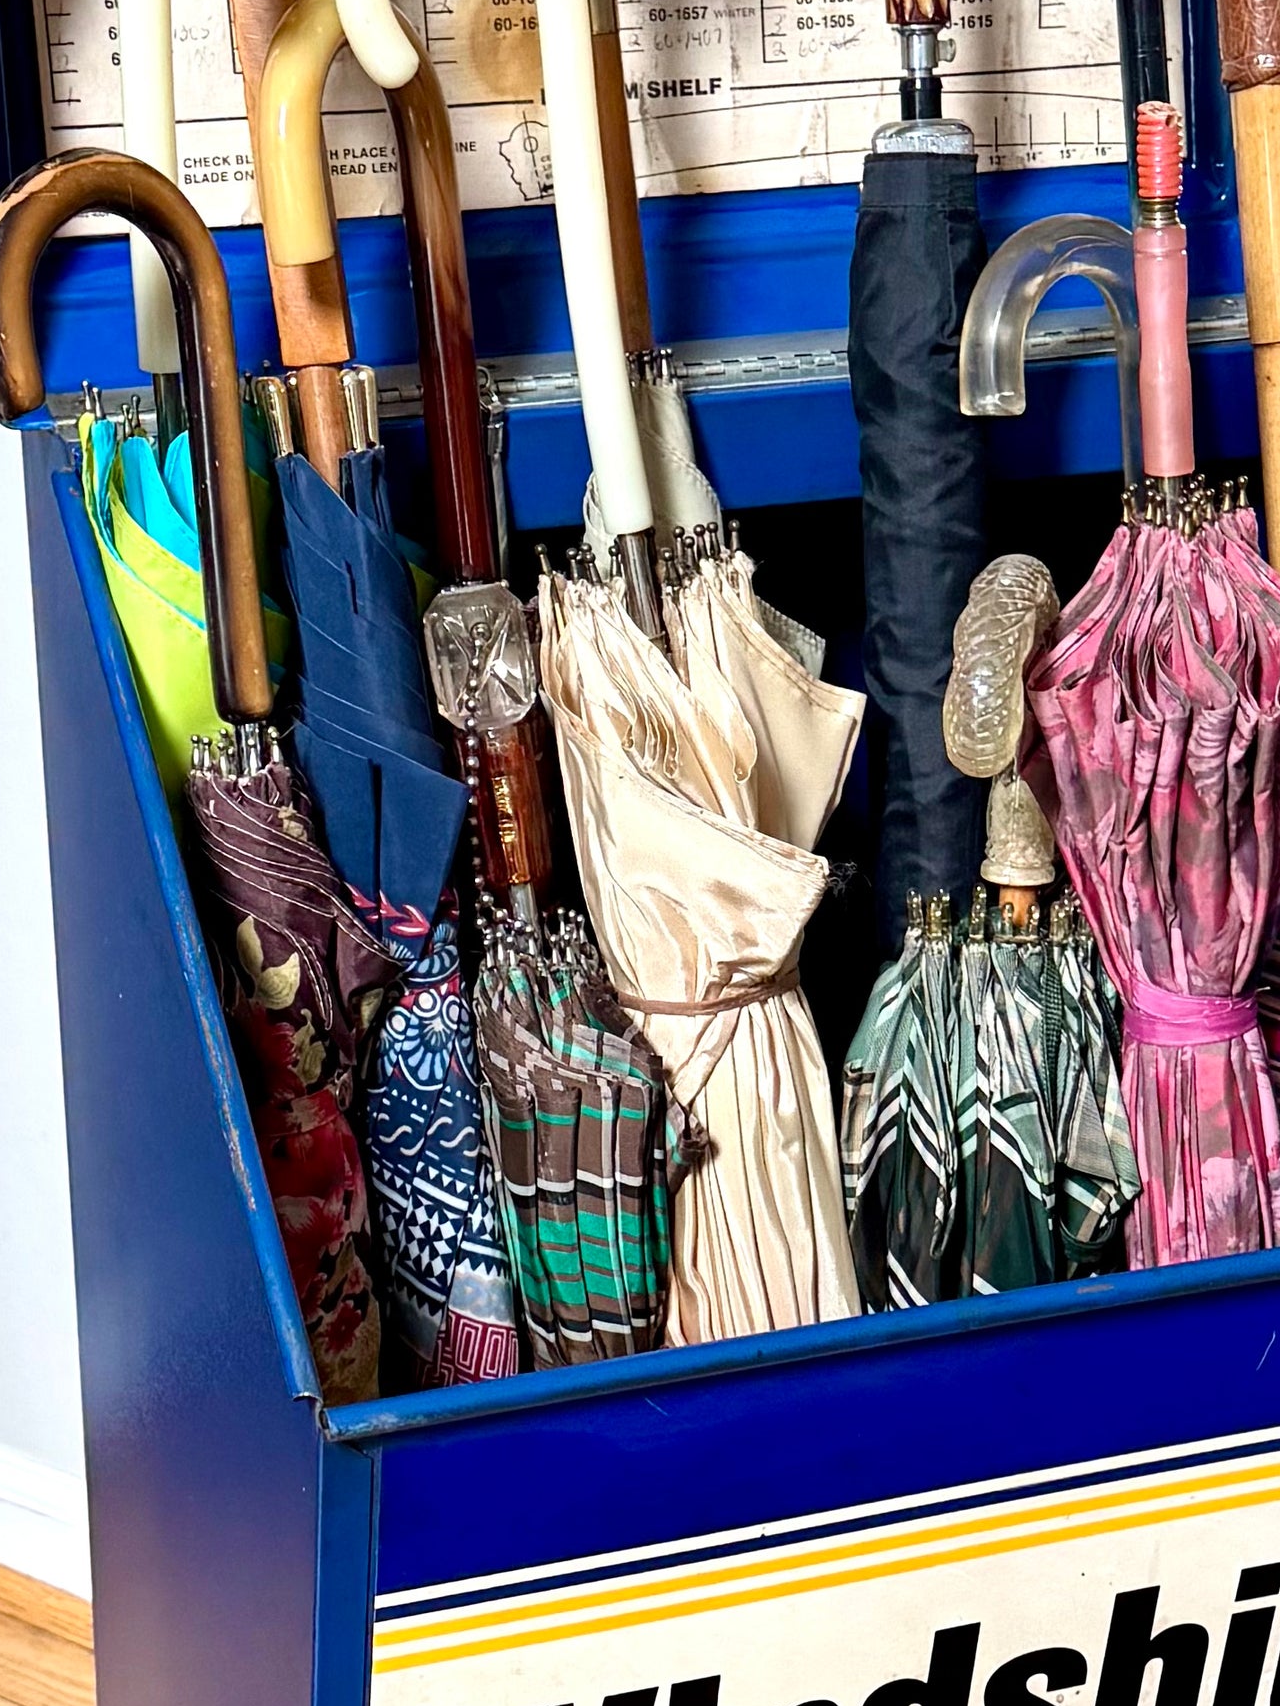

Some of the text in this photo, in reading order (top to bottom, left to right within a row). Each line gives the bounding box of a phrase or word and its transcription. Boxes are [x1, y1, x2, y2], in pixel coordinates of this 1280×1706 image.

[648, 7, 756, 22] 60-1657 WINTER
[953, 15, 993, 29] -1615
[494, 17, 537, 32] 60-16
[797, 15, 855, 30] 60-1505
[647, 77, 722, 98] SHELF
[184, 155, 231, 169] CHECK
[344, 147, 388, 159] PLACE
[456, 141, 477, 153] INE
[184, 171, 229, 184] BLADE
[331, 163, 366, 176] READ
[372, 163, 398, 174] LEN
